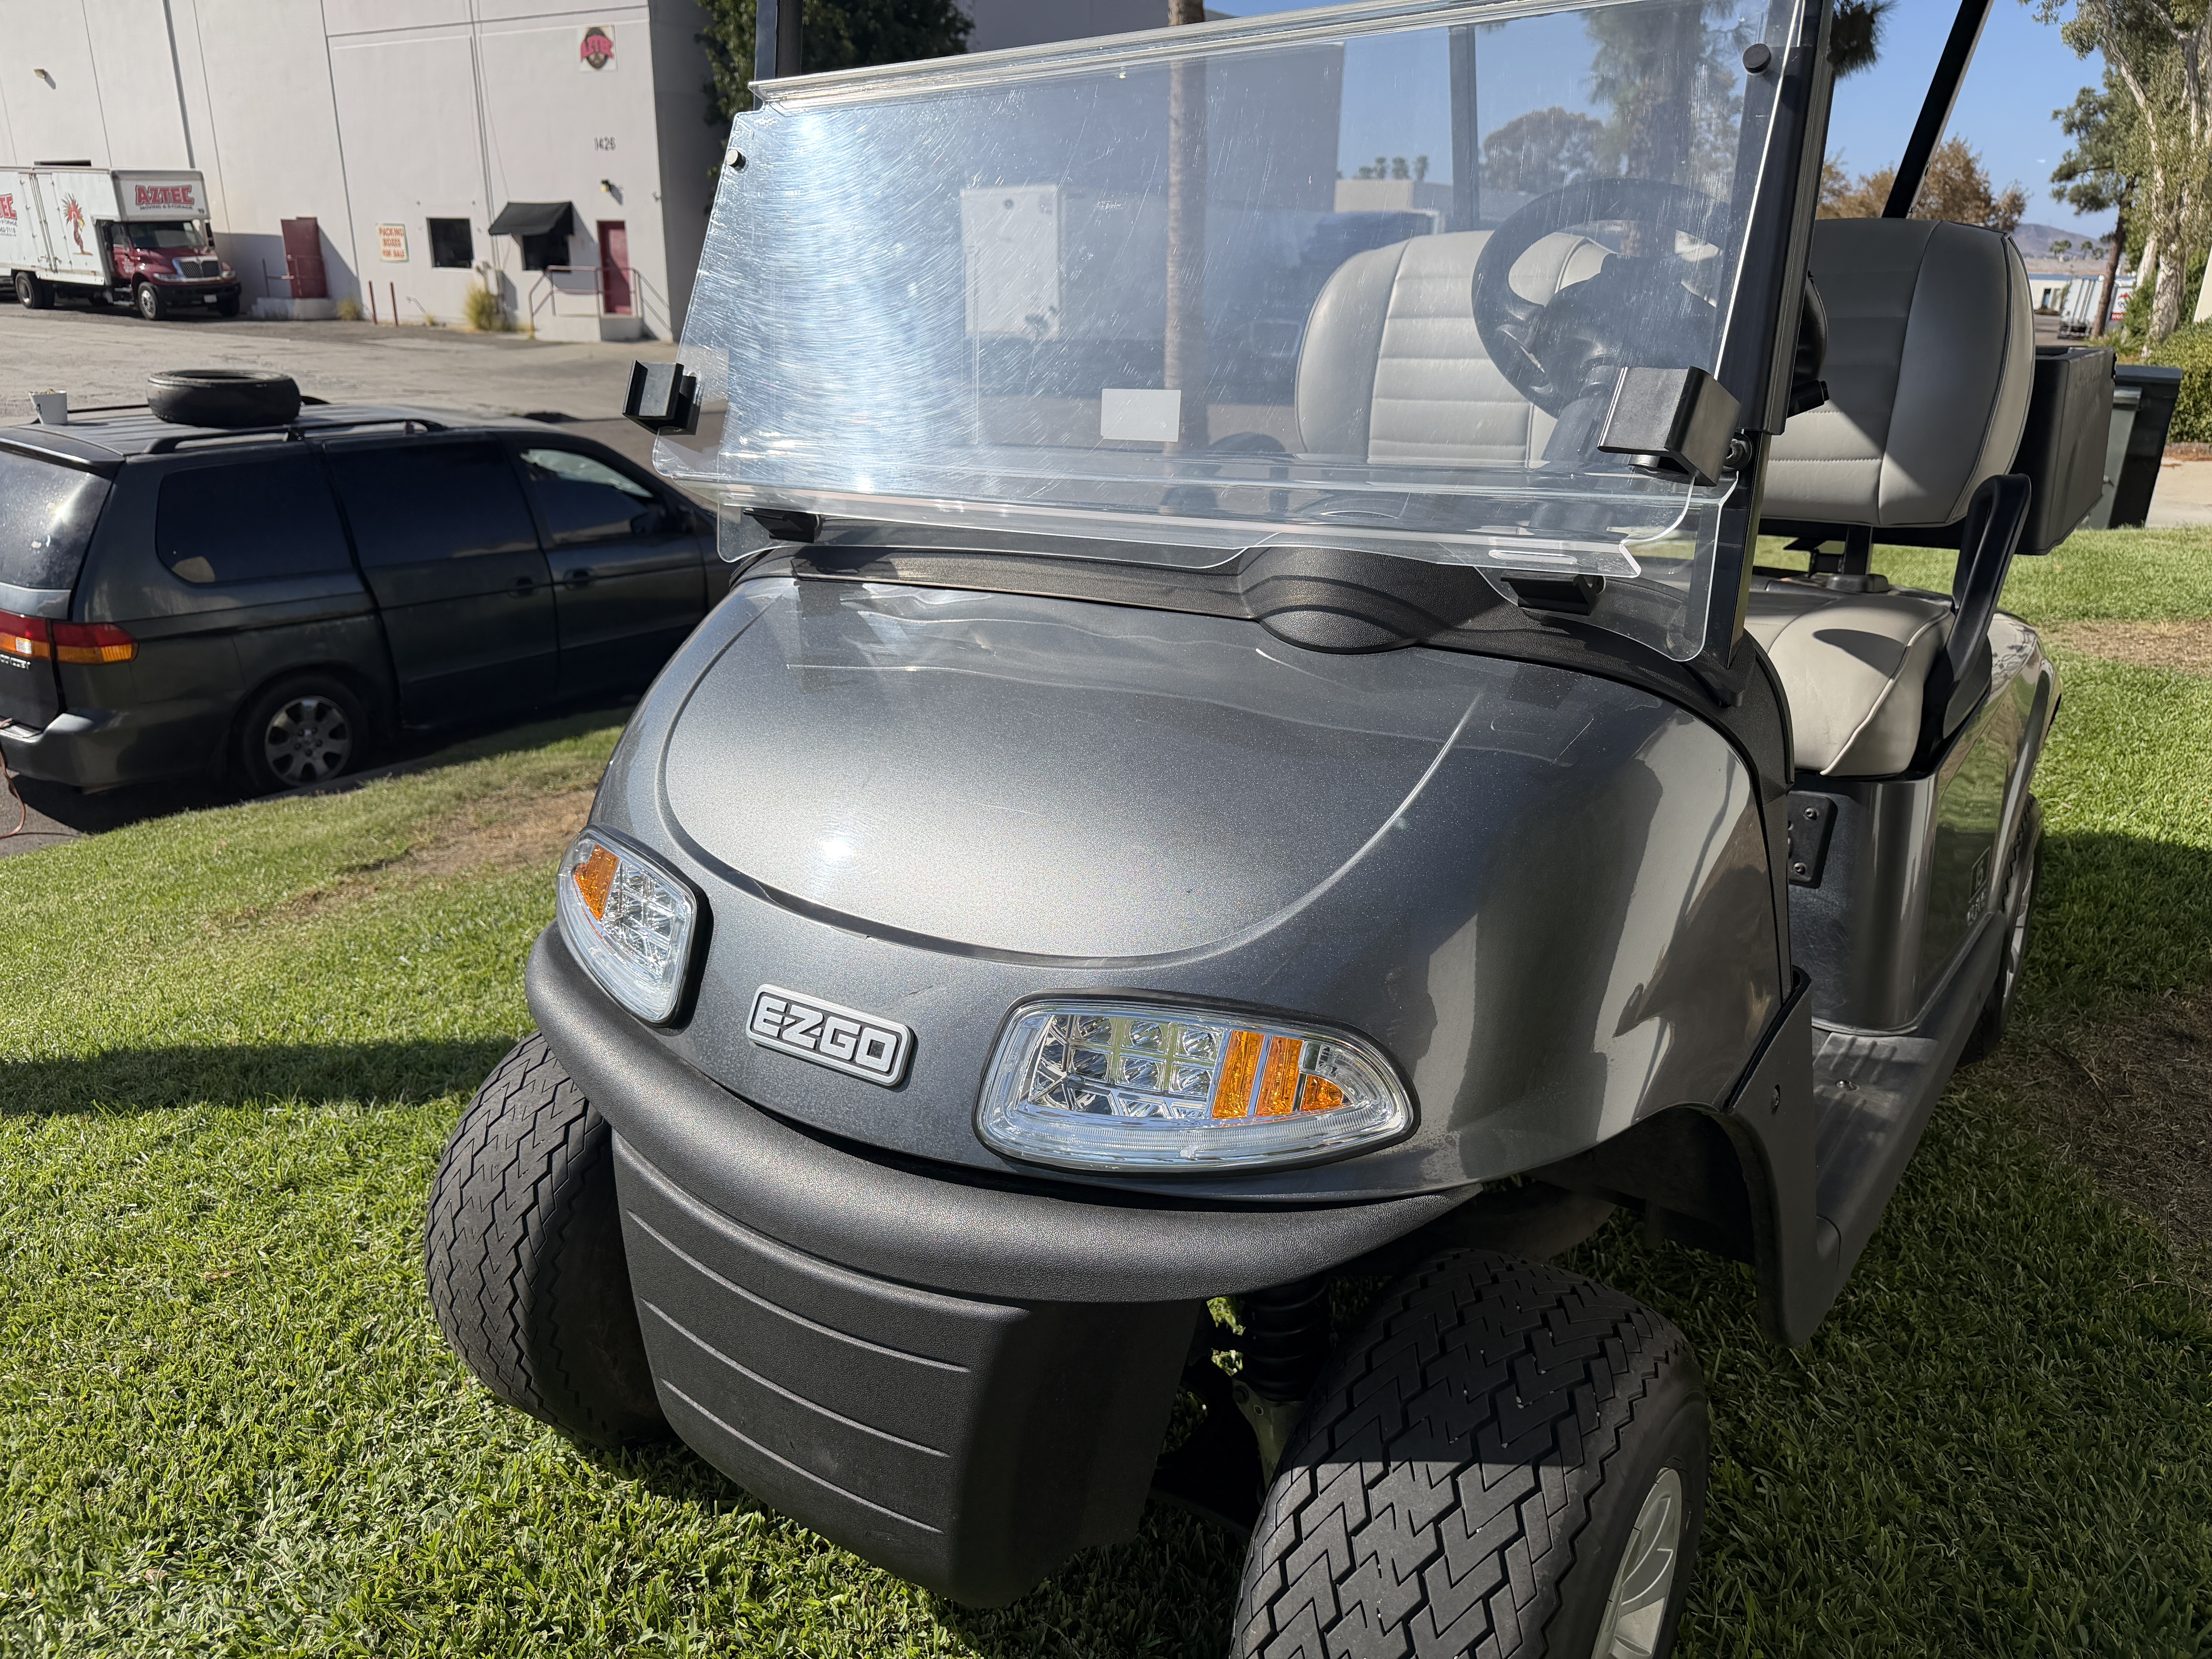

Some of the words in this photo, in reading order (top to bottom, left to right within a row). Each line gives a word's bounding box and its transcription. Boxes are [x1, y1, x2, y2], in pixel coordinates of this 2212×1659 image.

[594, 136, 616, 151] 1426
[136, 185, 194, 205] AZTEC
[753, 996, 897, 1072] EZGO
